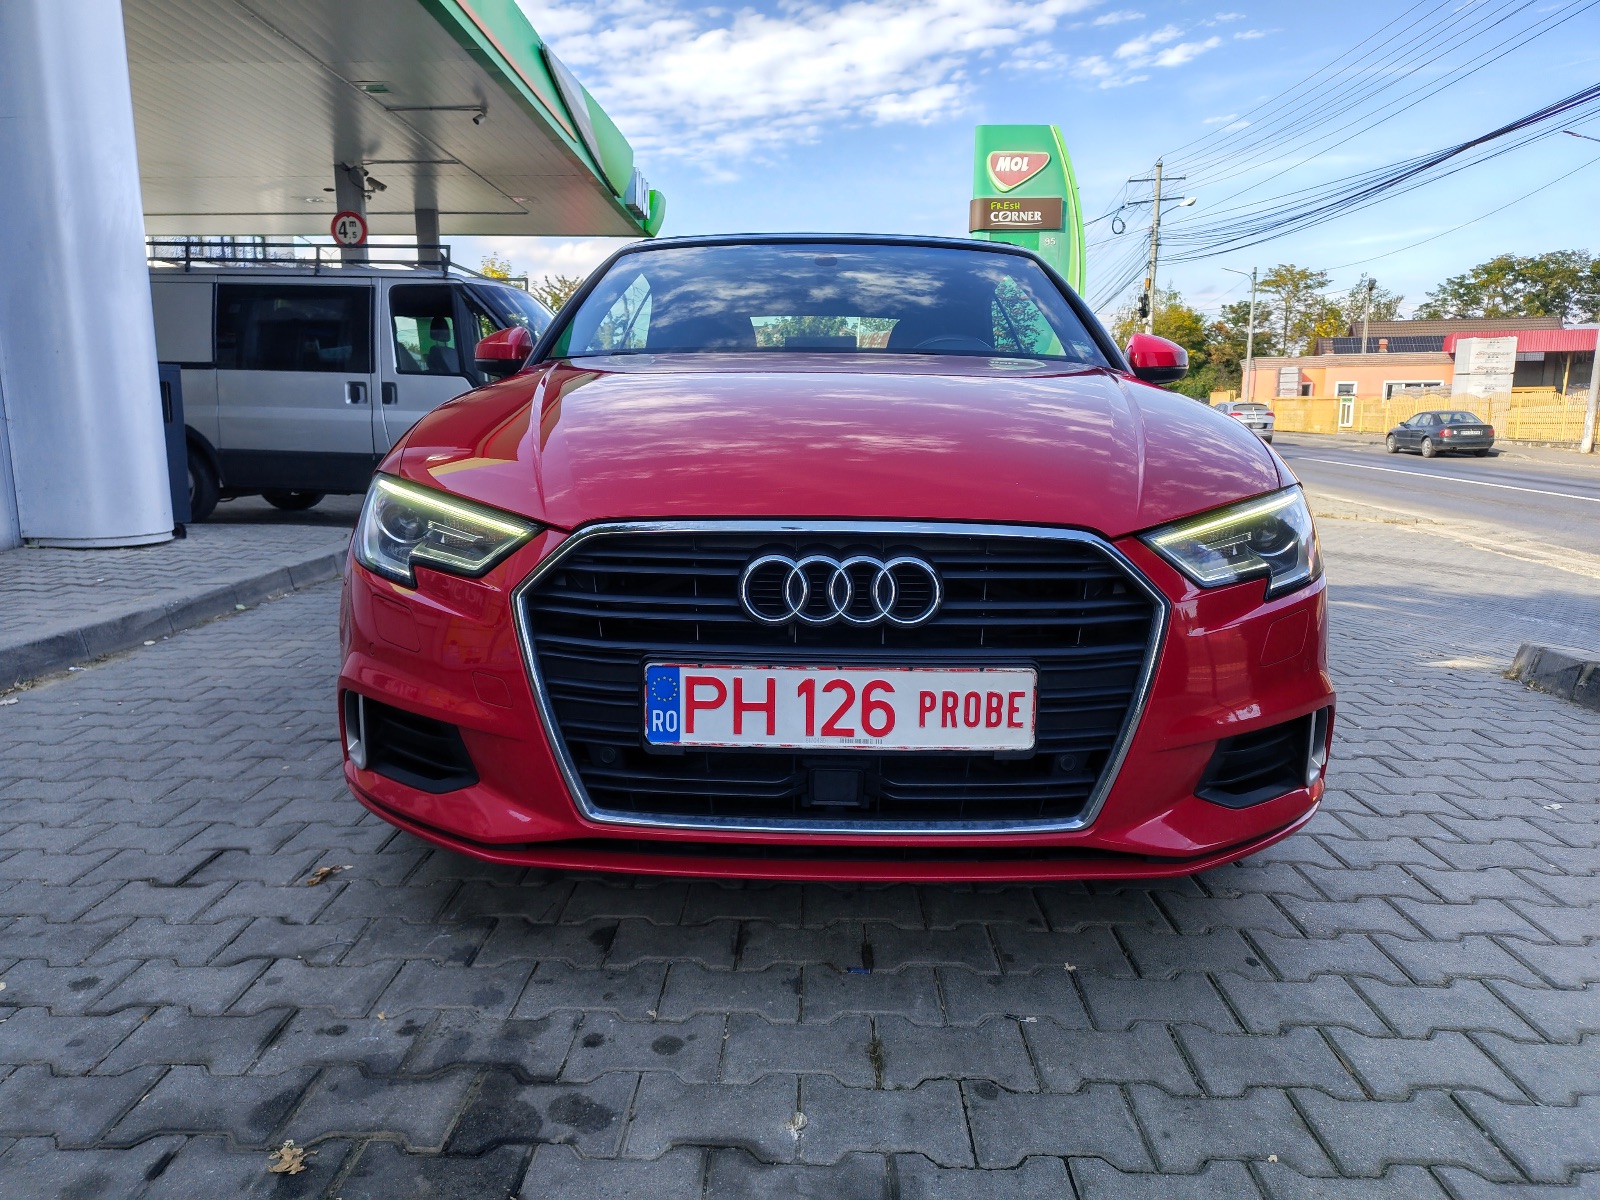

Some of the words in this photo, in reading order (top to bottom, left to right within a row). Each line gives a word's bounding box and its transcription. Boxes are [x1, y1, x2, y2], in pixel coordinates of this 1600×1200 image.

[995, 156, 1029, 172] MOL
[990, 201, 1020, 210] FRESH
[990, 211, 1042, 222] CORNER
[338, 220, 348, 238] 4
[1044, 237, 1056, 246] 95
[684, 676, 776, 736] PH
[797, 678, 896, 738] 126
[918, 690, 1026, 729] PROBE
[652, 709, 678, 733] RO
